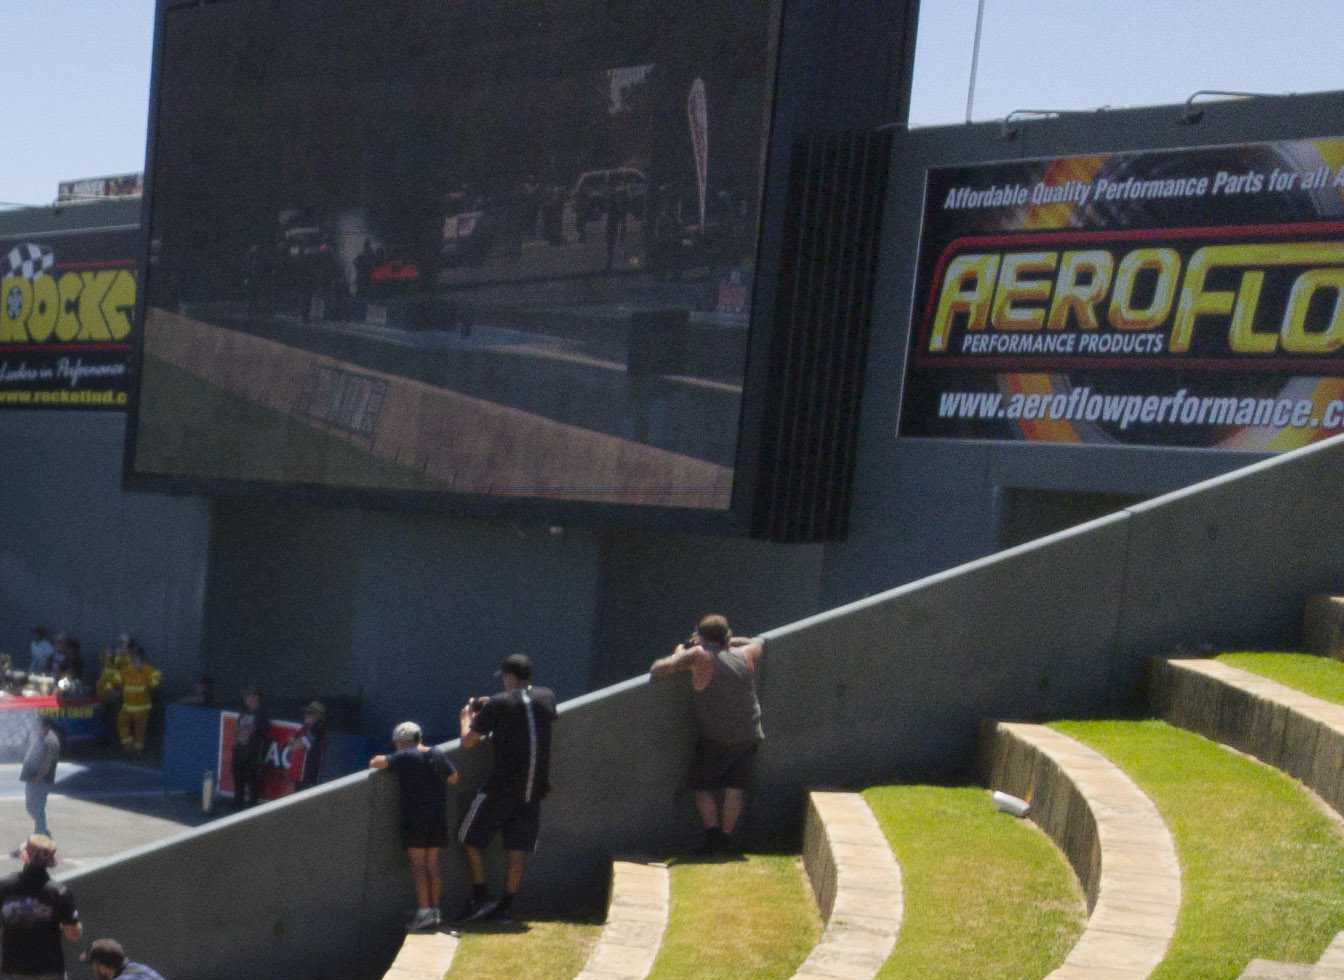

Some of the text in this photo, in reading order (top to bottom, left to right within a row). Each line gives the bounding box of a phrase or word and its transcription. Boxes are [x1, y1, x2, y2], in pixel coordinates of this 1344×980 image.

[944, 183, 1028, 210] Affordable
[1032, 180, 1091, 207] Quality
[1093, 176, 1209, 201] Performance
[1213, 170, 1264, 195] Parts
[1268, 167, 1300, 192] for
[1301, 167, 1330, 191] all
[962, 333, 1164, 354] PERFORMANCE PRODUCTS
[938, 386, 1344, 430] www.aeroflowperformance.c
